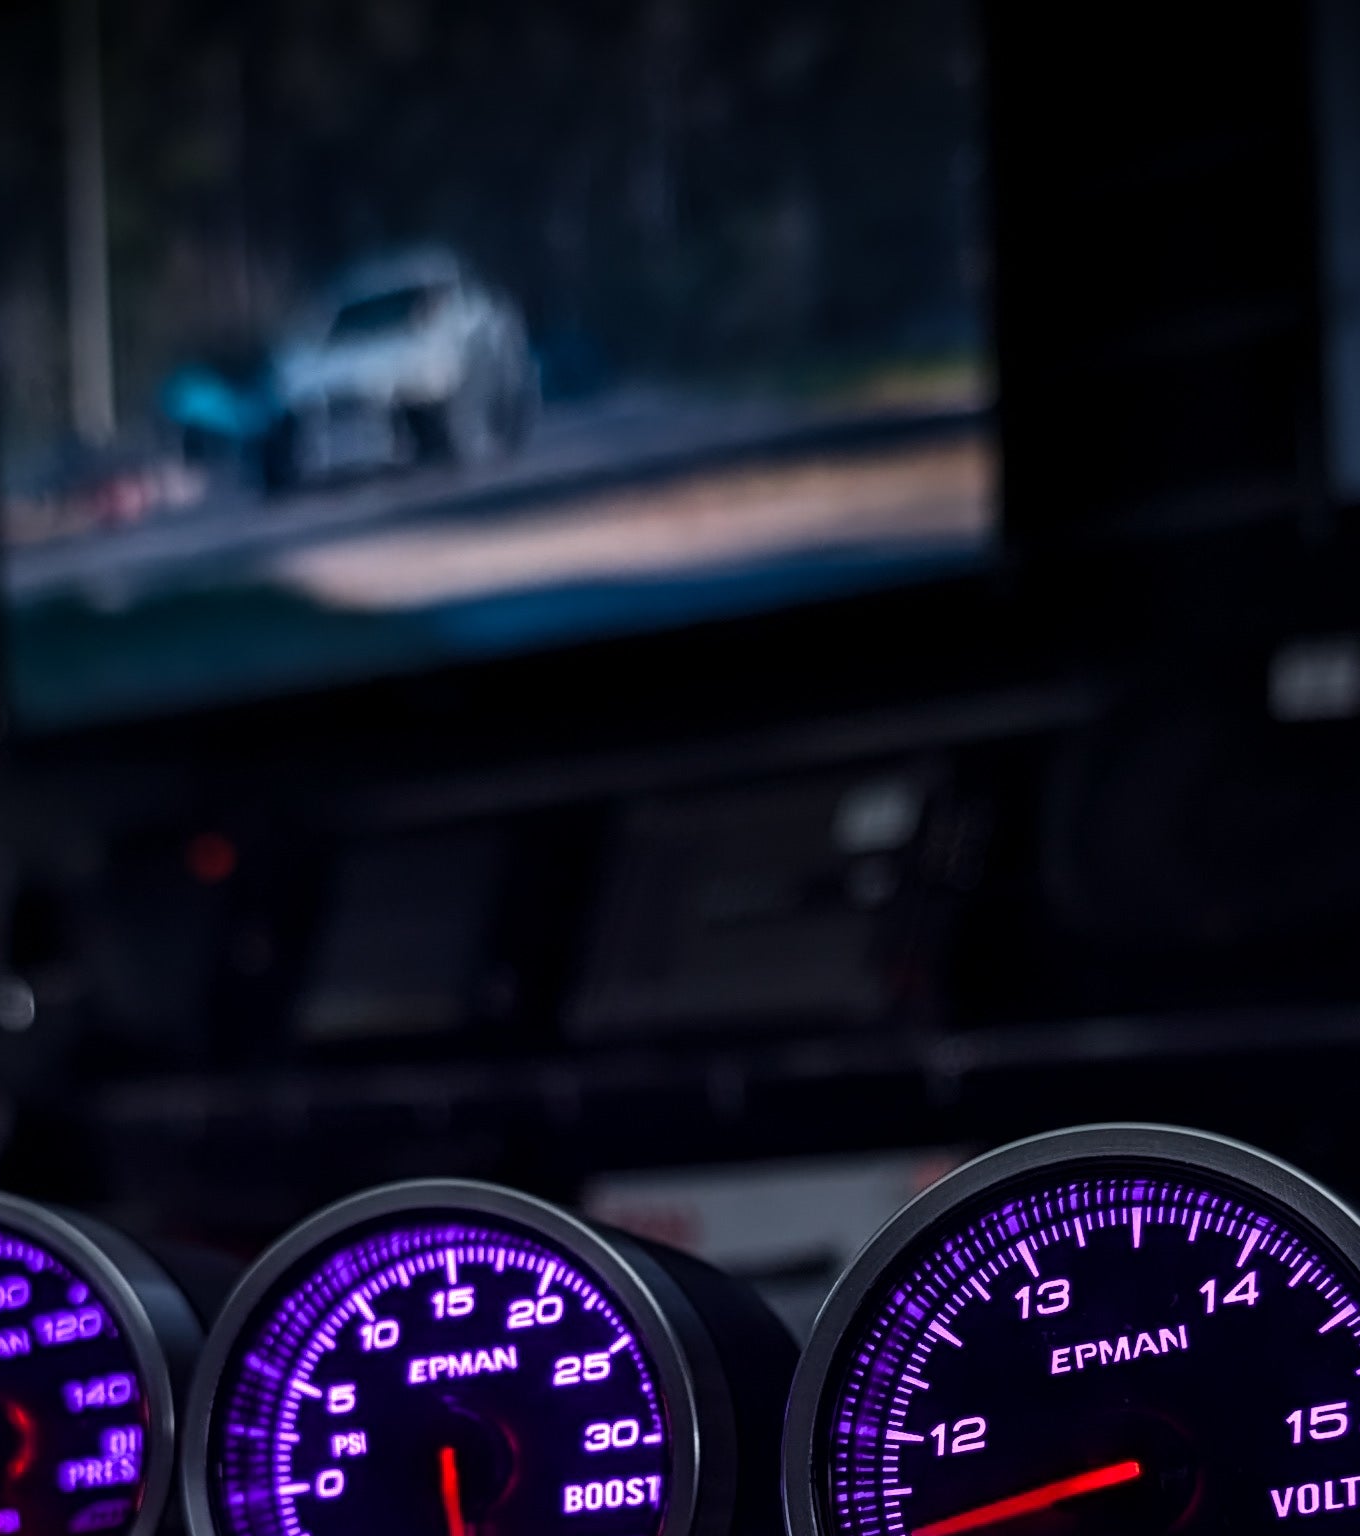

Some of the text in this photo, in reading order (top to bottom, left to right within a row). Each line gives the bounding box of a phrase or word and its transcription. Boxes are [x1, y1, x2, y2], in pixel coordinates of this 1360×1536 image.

[432, 1286, 475, 1320] 15
[1014, 1278, 1071, 1319] 13
[1199, 1273, 1260, 1314] 14
[34, 1308, 103, 1345] 120
[507, 1295, 564, 1330] 20
[359, 1319, 400, 1352] 10
[1050, 1325, 1188, 1375] EPMAN
[408, 1346, 518, 1384] EPMAN
[553, 1351, 611, 1387] 25
[327, 1383, 358, 1414] 5
[584, 1419, 640, 1452] 30
[930, 1416, 987, 1456] 12
[1286, 1402, 1349, 1445] 15
[332, 1431, 367, 1457] PSI
[315, 1469, 346, 1499] 0
[564, 1475, 661, 1514] BOOST
